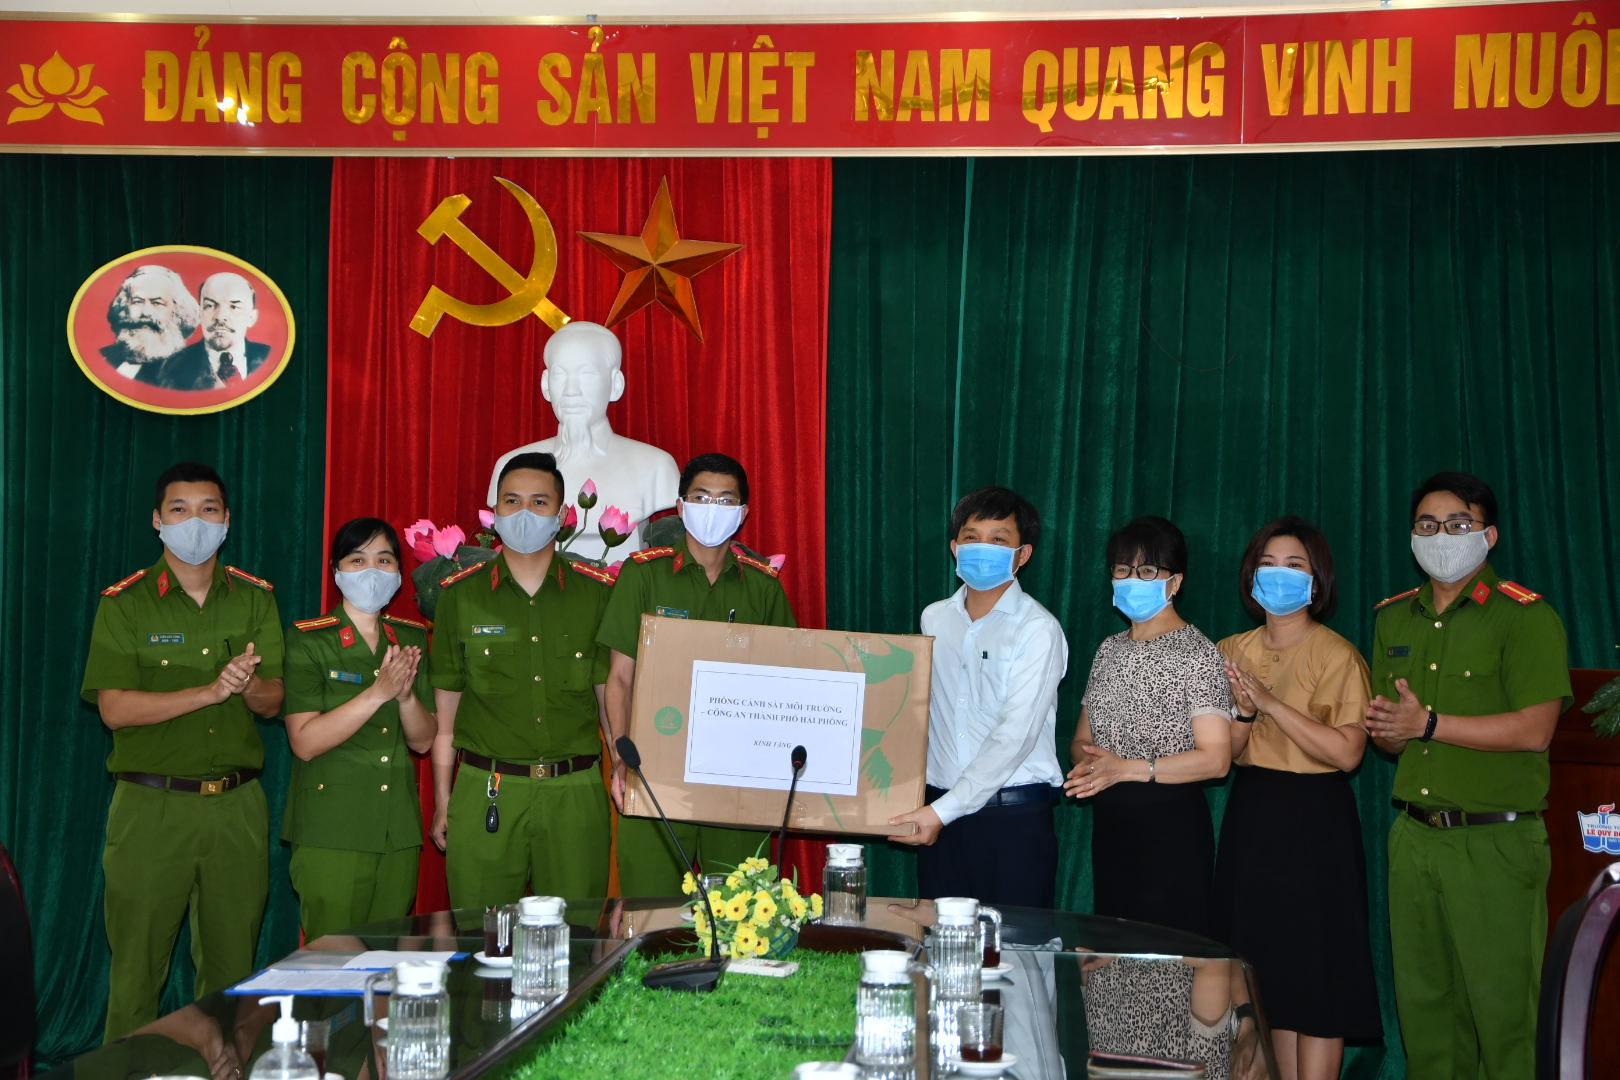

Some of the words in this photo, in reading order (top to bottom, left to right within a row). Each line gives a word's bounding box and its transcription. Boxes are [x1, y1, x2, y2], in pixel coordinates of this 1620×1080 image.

[142, 26, 302, 124] ĐẢNG
[342, 36, 499, 141] CỘNG
[538, 26, 656, 126] SẢN
[690, 34, 816, 139] VIỆT
[854, 48, 992, 123] NAM
[1021, 41, 1226, 134] QUANG
[1261, 36, 1413, 117] VINH
[785, 701, 803, 711] MÔI
[707, 708, 732, 718] CÔNG
